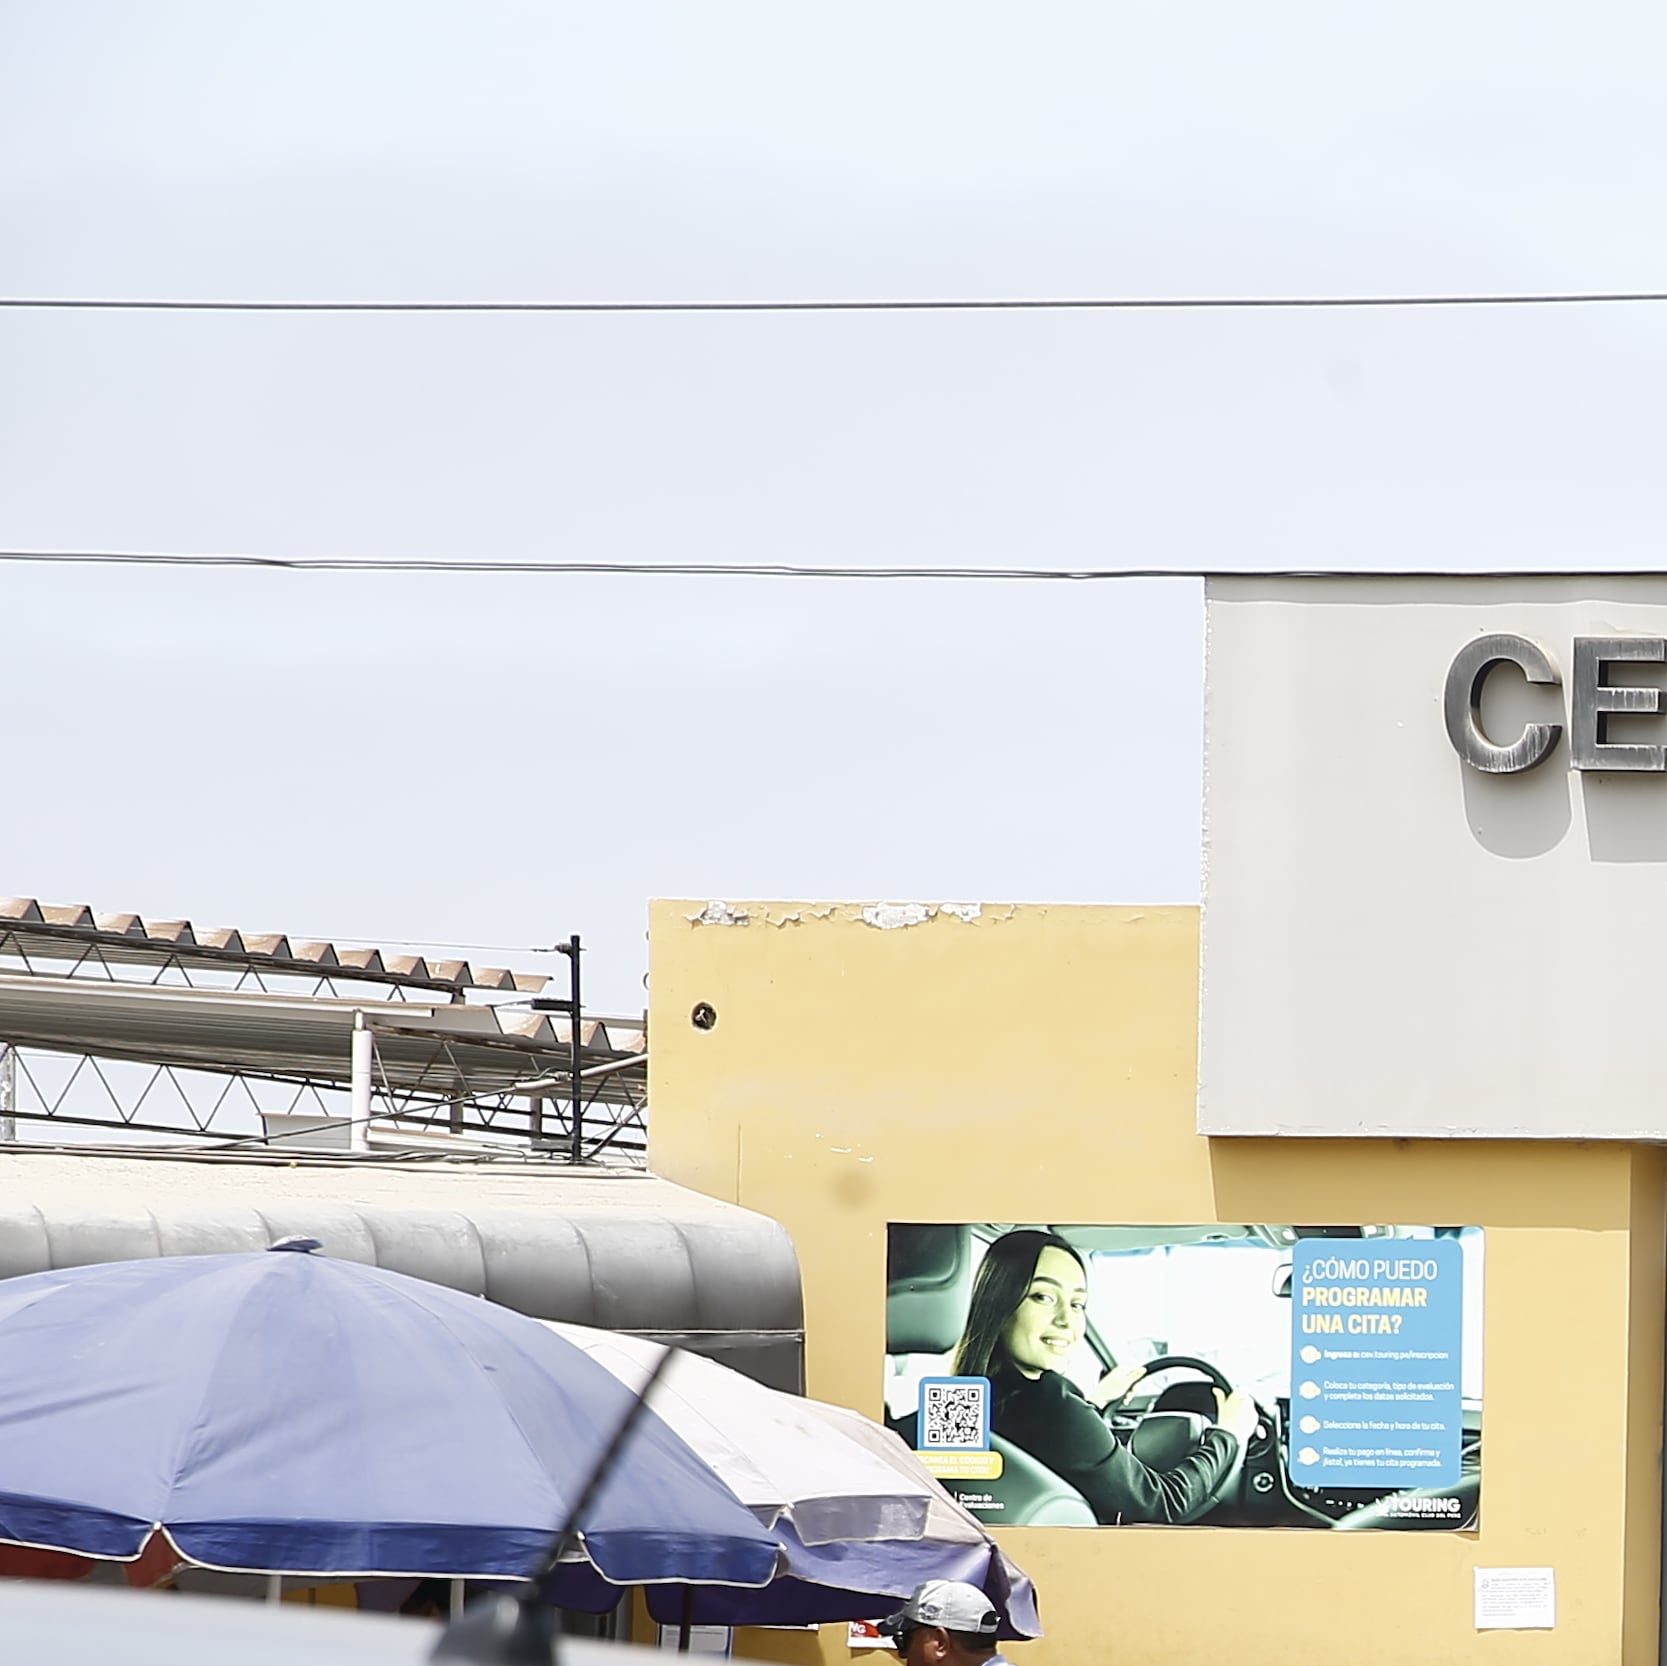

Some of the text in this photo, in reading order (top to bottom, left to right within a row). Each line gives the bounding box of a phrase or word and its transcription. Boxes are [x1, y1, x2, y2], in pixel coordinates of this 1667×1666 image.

[1302, 1256, 1438, 1283] ¿CÓMO PUEDO
[1302, 1287, 1427, 1307] PROGRAMAR
[1302, 1314, 1402, 1334] UNA CITA?
[1390, 1498, 1461, 1512] TOURING
